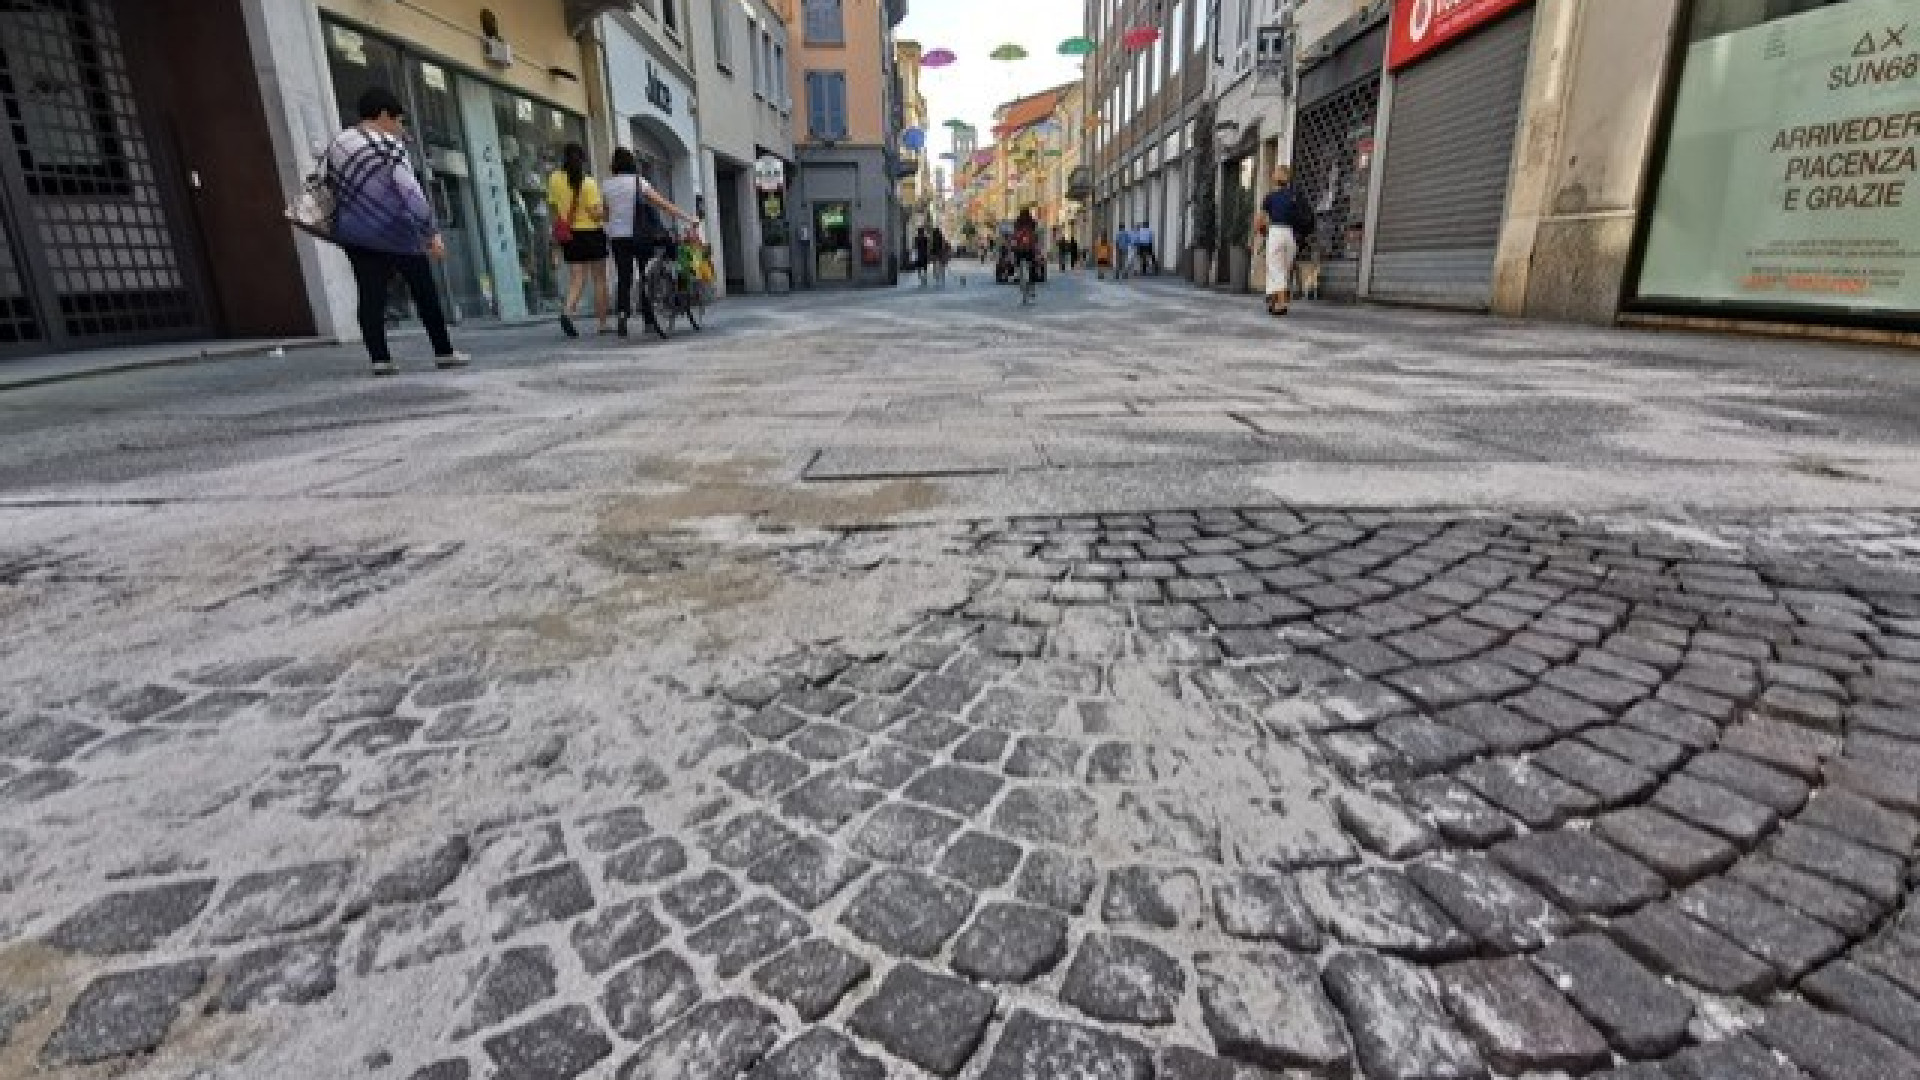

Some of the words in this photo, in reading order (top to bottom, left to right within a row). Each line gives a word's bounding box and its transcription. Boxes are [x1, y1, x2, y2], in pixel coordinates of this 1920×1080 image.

[1827, 53, 1918, 90] SUN68
[1785, 146, 1917, 181] PIACENZA
[1784, 188, 1800, 211] E
[1806, 180, 1905, 211] GRAZIE
